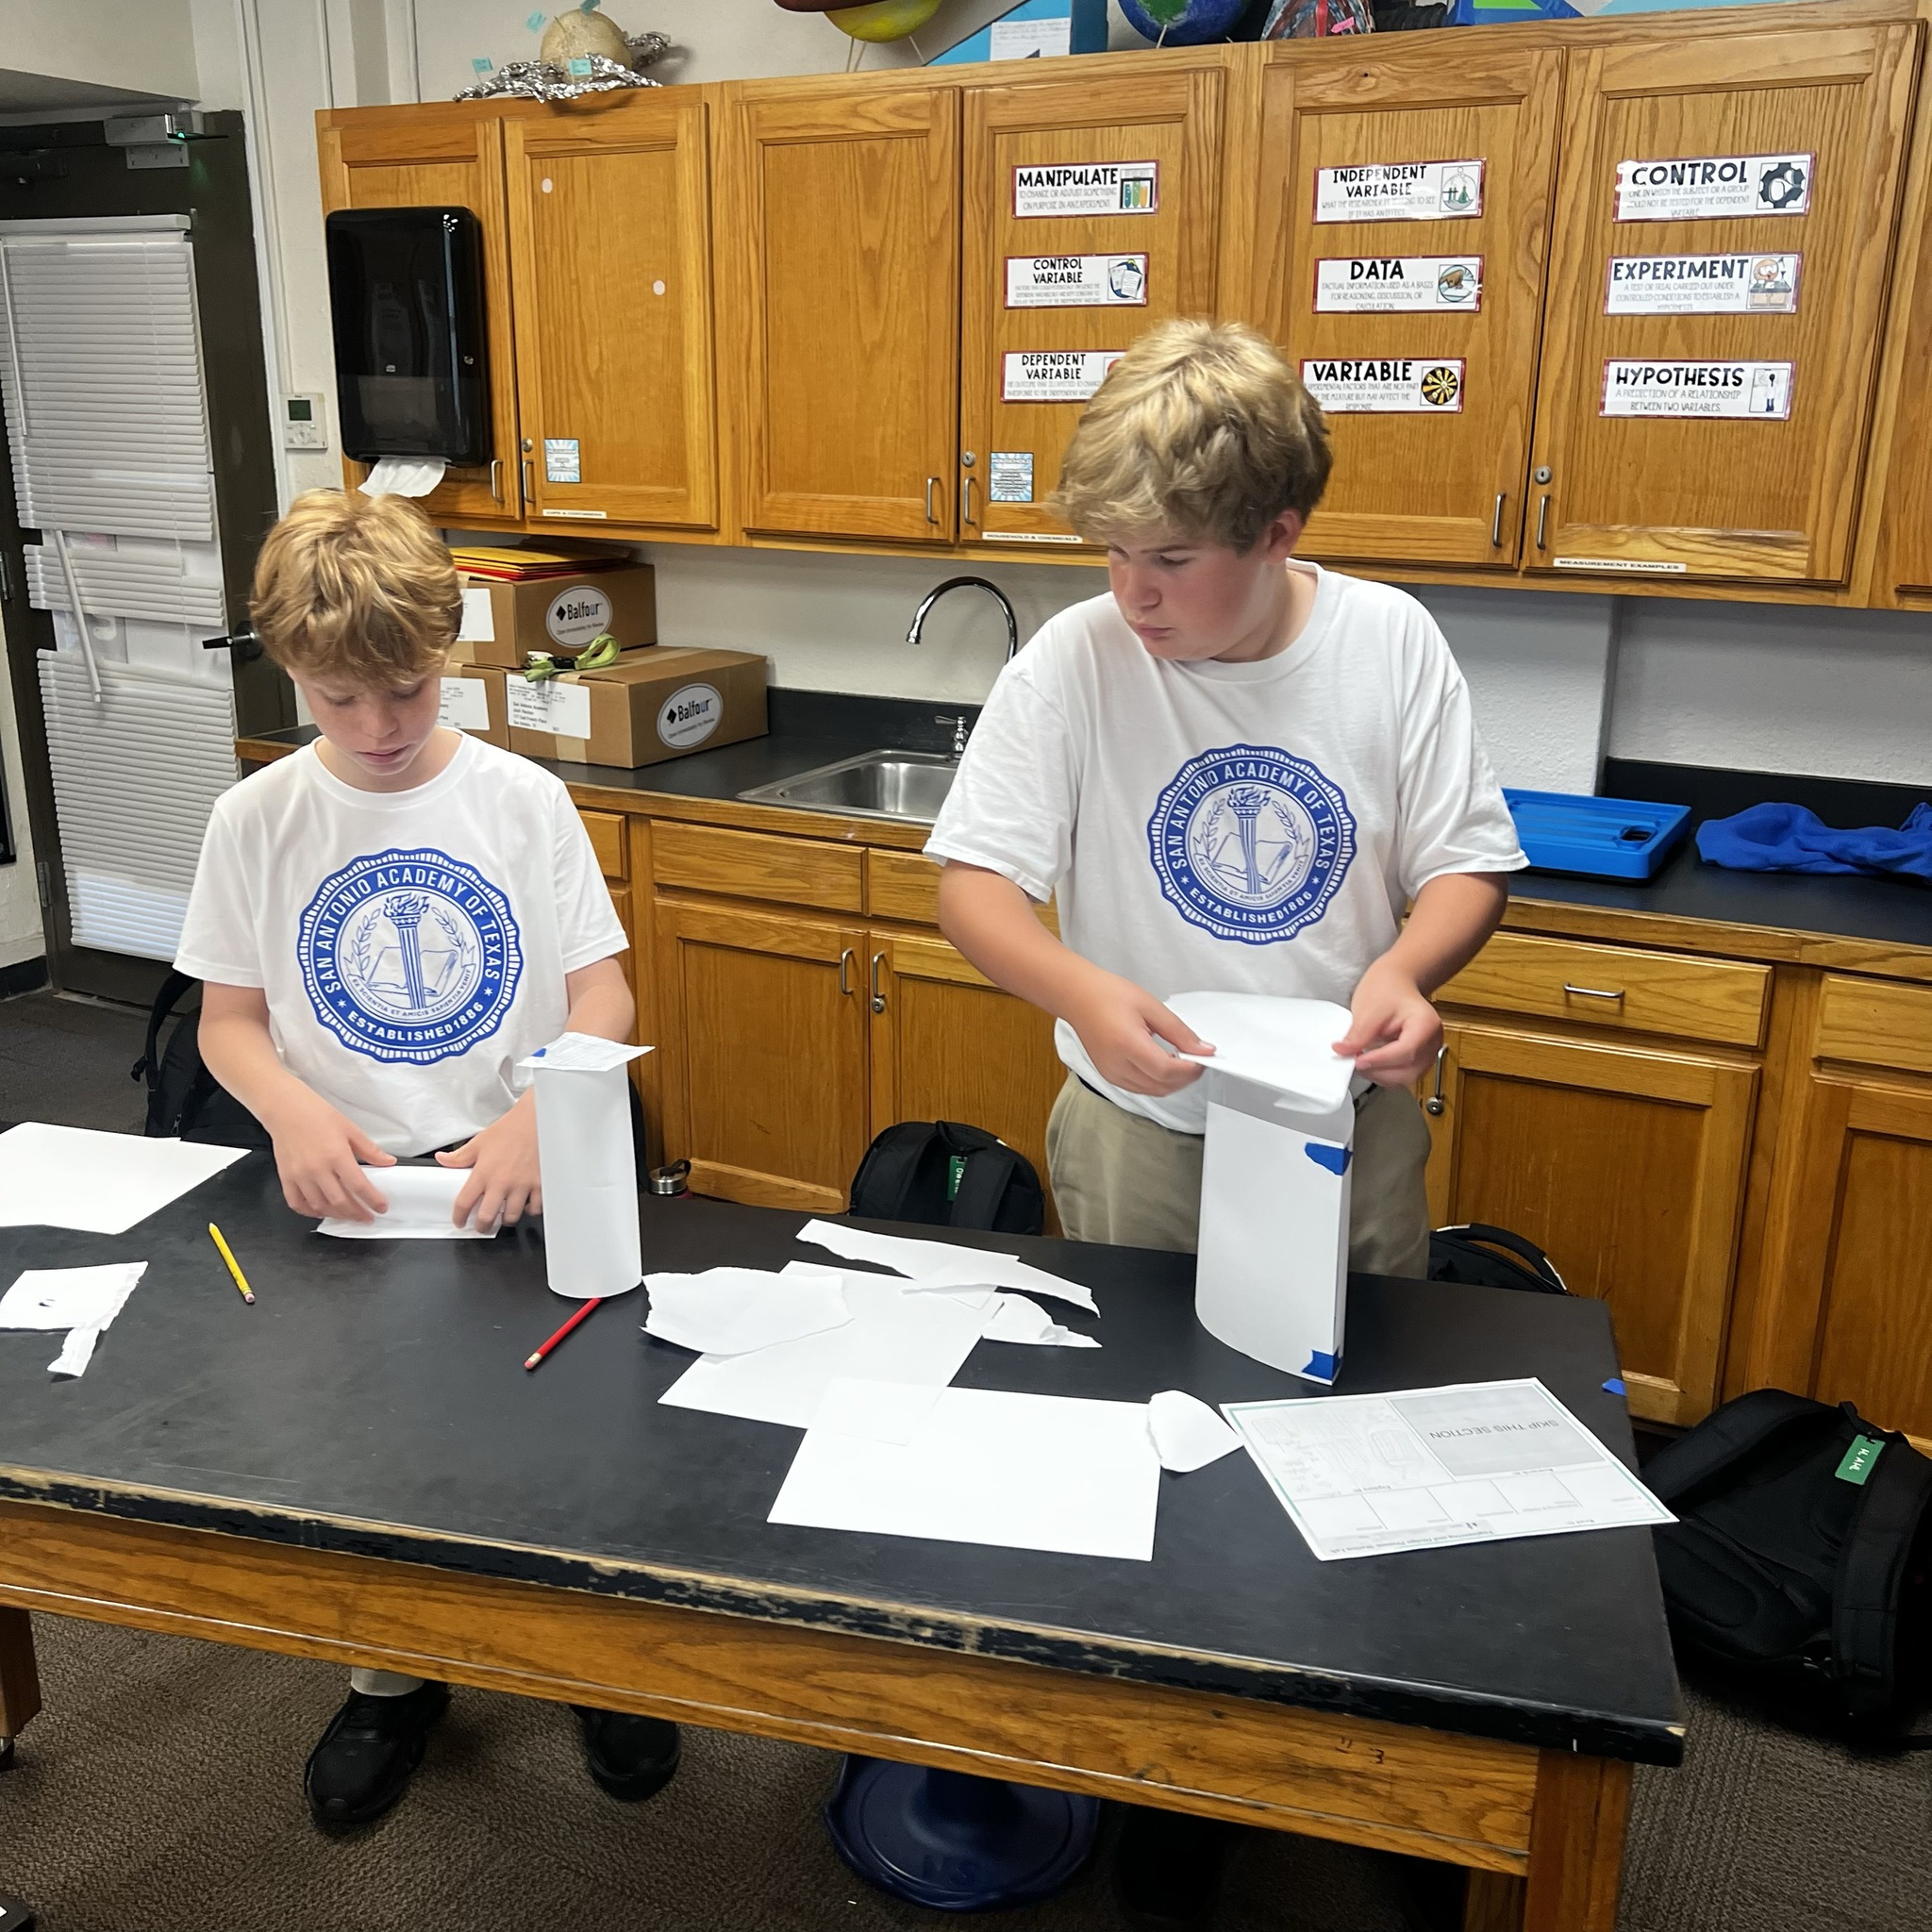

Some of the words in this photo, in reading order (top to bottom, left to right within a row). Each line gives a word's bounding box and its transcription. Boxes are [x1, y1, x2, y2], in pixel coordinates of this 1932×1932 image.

[1019, 168, 1118, 187] MANIPULATE
[1334, 166, 1426, 183] INDEPENDENT
[1632, 161, 1747, 186] CONTROL
[1346, 183, 1412, 198] VARIABLE
[1034, 258, 1082, 270] CONTROL
[1351, 260, 1404, 280] DATA
[1613, 258, 1749, 281] EXPERIMENT
[1034, 272, 1083, 284] VARIABLE
[1023, 354, 1086, 366] DEPENDENT
[1026, 368, 1081, 379] VARIABLE
[1313, 362, 1411, 381] VARIABLE
[1615, 367, 1745, 387] HYPOTHESIS
[1623, 389, 1667, 398] PREDICTION
[1668, 390, 1679, 398] OF
[1689, 391, 1741, 400] RELATIONSHIP
[1630, 402, 1661, 411] BETWEEN
[1664, 402, 1679, 411] TWO
[568, 601, 599, 620] Balfour
[678, 700, 709, 722] Balfour
[1224, 762, 1307, 792] ACADEMY
[1170, 770, 1219, 830] ANTONIO
[1304, 790, 1325, 810] OF
[1317, 813, 1337, 870] TEXAS
[1168, 836, 1187, 870] SAN
[377, 868, 468, 898] ACADEMY
[315, 878, 372, 951] ANTONIO
[465, 896, 489, 919] OF
[1191, 888, 1284, 923] ESTABLISHED
[1283, 891, 1313, 915] 1886
[480, 919, 502, 980] TEXAS
[316, 957, 341, 994] SAN
[359, 987, 389, 1012] SCIENTIA
[432, 991, 460, 1013] SAPIENTIA
[460, 970, 472, 989] VENIT
[347, 1009, 453, 1041] ESTABLISHED
[453, 1000, 485, 1030] 1886
[1429, 1426, 1492, 1440] SECTION
[1492, 1423, 1526, 1432] THIS
[1528, 1419, 1558, 1430] SKIP
